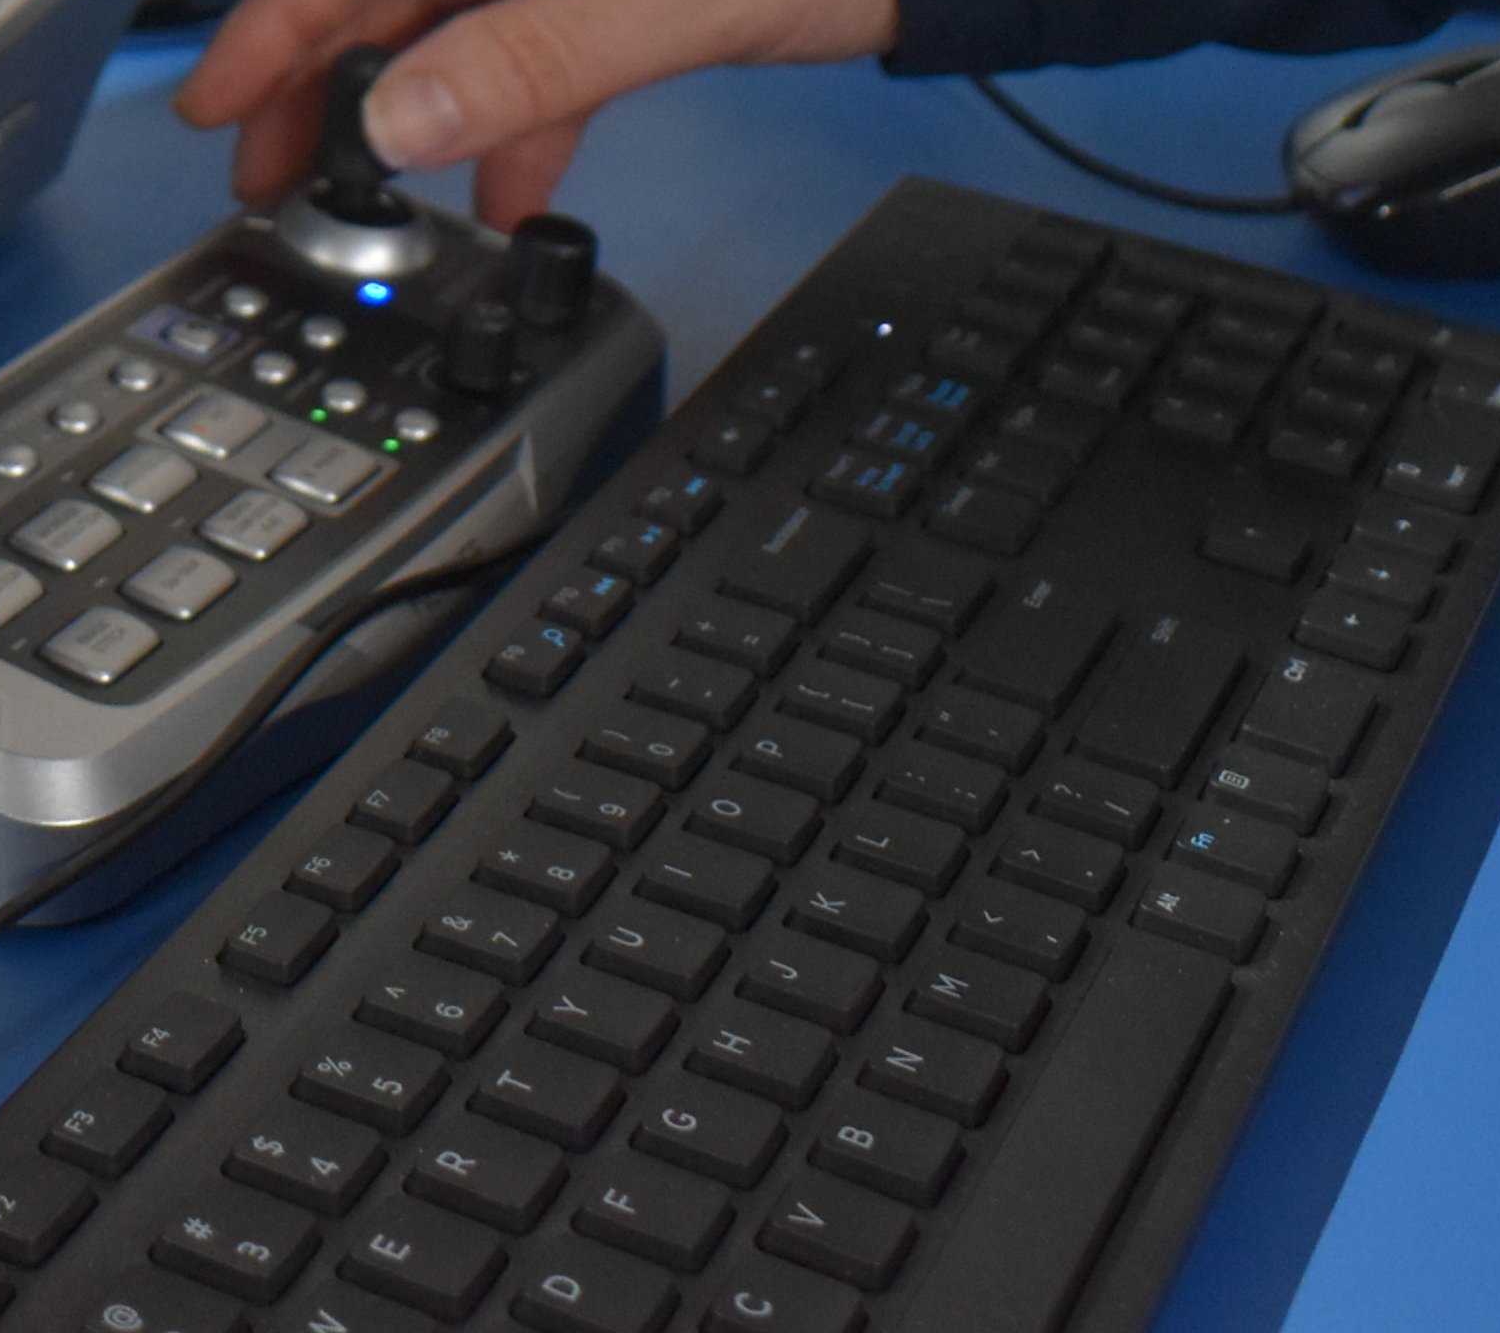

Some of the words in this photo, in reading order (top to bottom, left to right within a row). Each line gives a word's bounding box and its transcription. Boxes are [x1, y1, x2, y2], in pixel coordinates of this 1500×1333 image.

[602, 729, 630, 742] )
[755, 740, 782, 757] P
[365, 789, 390, 808] F7
[552, 787, 581, 801] (
[599, 803, 627, 817] 9
[711, 799, 742, 816] O
[856, 835, 889, 848] L
[303, 856, 331, 875] F6
[547, 866, 575, 881] 8
[663, 864, 692, 878] I
[810, 891, 846, 914] K
[441, 916, 473, 931] &
[239, 924, 268, 945] F5
[491, 931, 518, 947] 7
[609, 926, 644, 947] U
[769, 959, 798, 980] J
[931, 973, 969, 998] M
[435, 1002, 464, 1018] 6
[553, 995, 588, 1016] Y
[141, 1027, 171, 1048] F4
[712, 1030, 751, 1055] H
[317, 1056, 352, 1077] %
[885, 1046, 924, 1072] N
[372, 1077, 403, 1095] 5
[496, 1069, 532, 1091] T
[63, 1109, 95, 1133] F3
[662, 1108, 697, 1131] G
[252, 1135, 285, 1156] $
[837, 1125, 874, 1149] B
[311, 1156, 339, 1176] 4
[435, 1150, 476, 1175] R
[602, 1188, 635, 1213] F
[787, 1202, 825, 1226] V
[183, 1217, 213, 1240] #
[236, 1241, 270, 1261] 3
[369, 1233, 411, 1261] E
[541, 1274, 581, 1301] D
[734, 1292, 773, 1316] C
[103, 1304, 142, 1331] @
